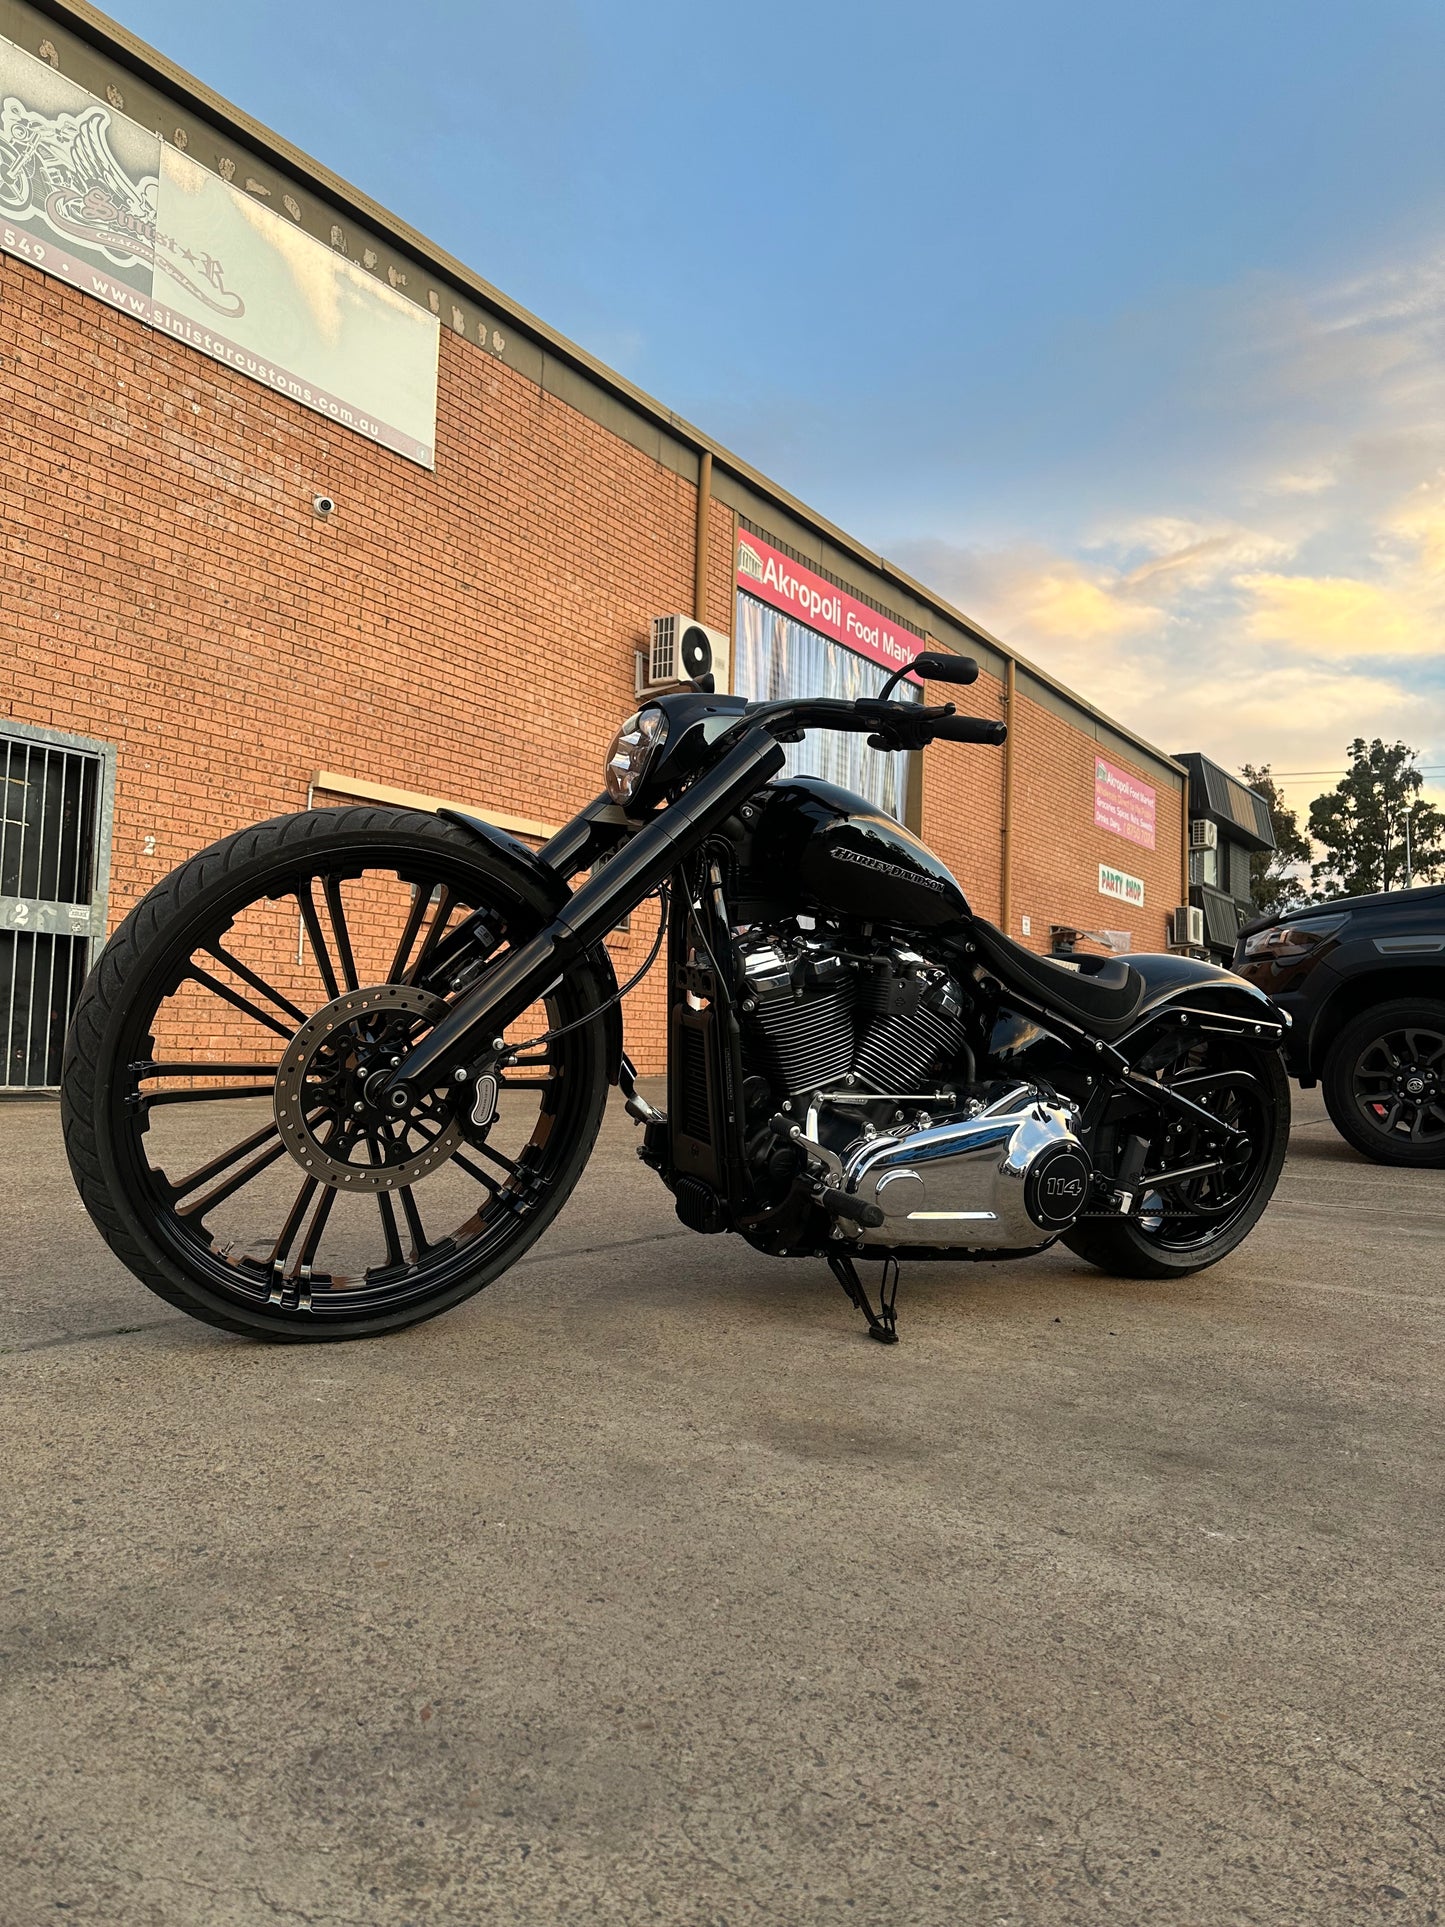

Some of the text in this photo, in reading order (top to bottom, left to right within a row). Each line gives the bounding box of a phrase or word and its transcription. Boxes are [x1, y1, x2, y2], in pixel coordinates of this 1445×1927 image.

[4, 228, 380, 436] 549 www.sinistarcustoms.com.au
[762, 556, 917, 665] Akropoli Food Mark
[143, 835, 156, 855] 2
[1101, 870, 1142, 901] PARTY SHOP
[14, 903, 29, 926] 2
[1047, 1177, 1082, 1196] 114
